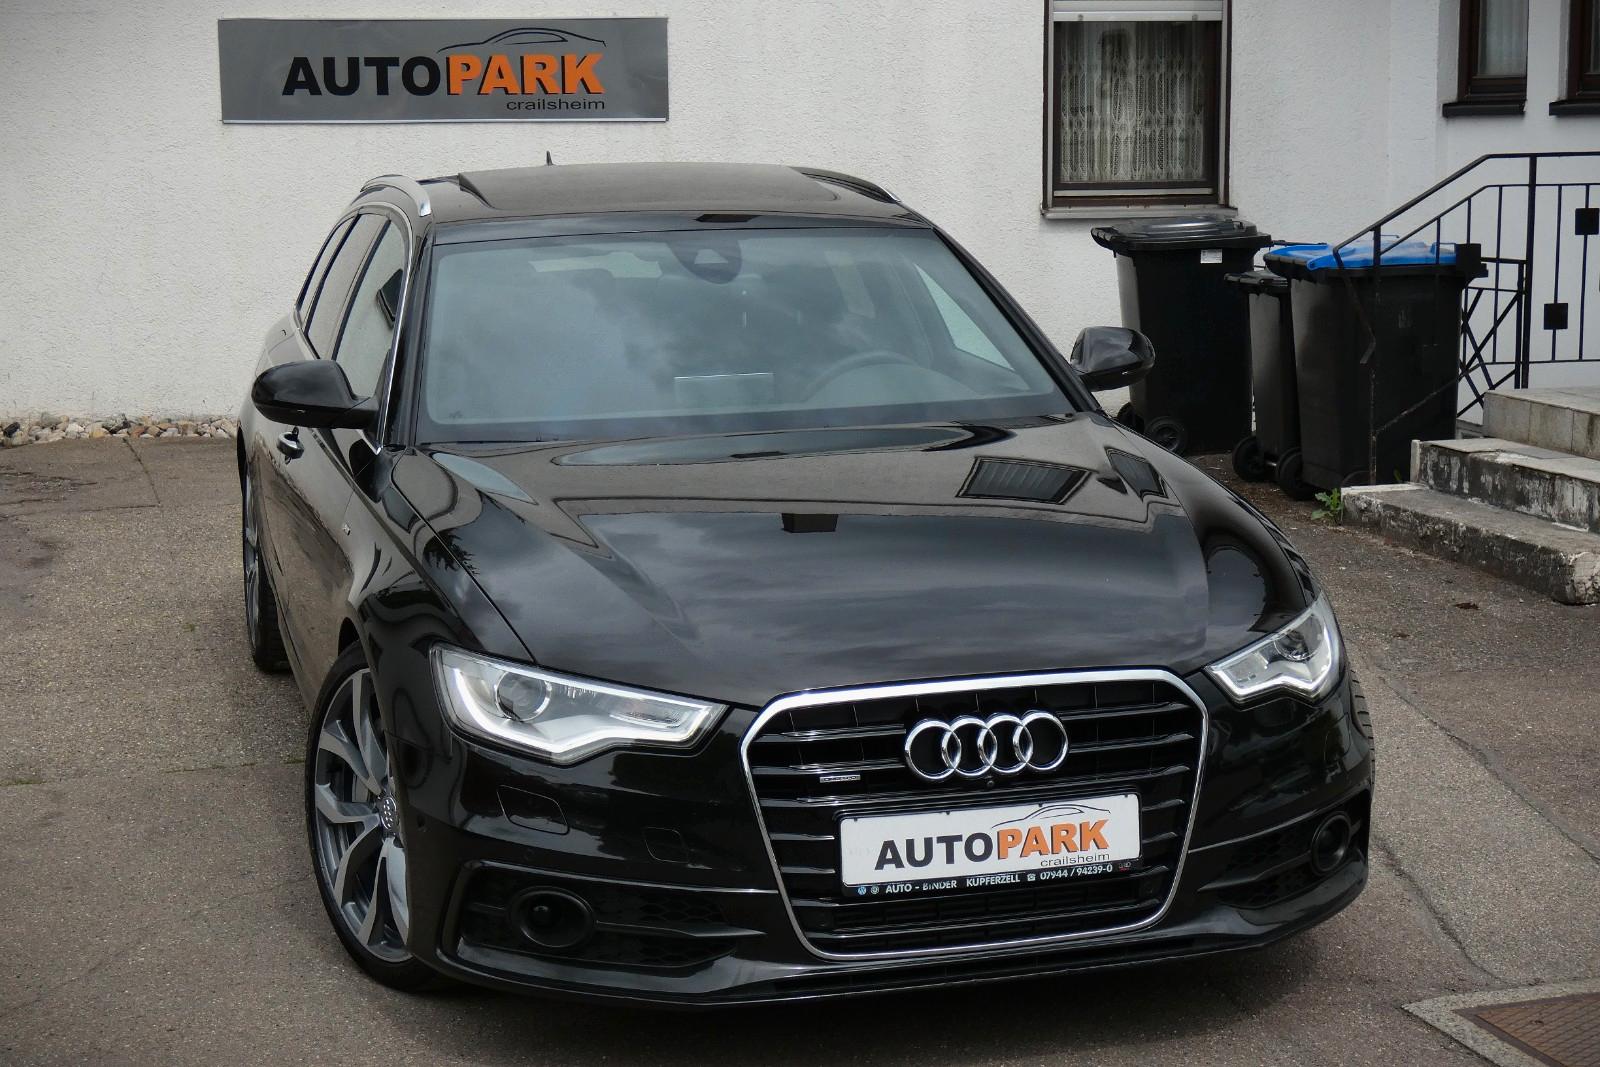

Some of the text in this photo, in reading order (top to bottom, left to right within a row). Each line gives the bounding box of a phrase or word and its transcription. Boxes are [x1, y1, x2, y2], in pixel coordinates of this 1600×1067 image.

[282, 53, 606, 97] AUTOPARK
[506, 97, 605, 110] crailsheim
[874, 818, 1109, 871] AUTOPARK
[1040, 853, 1110, 867] crailsheim
[885, 883, 912, 894] AUTO
[922, 880, 957, 891] BINDER
[966, 874, 1021, 887] KUPFERZELL
[1040, 869, 1069, 880] 07944
